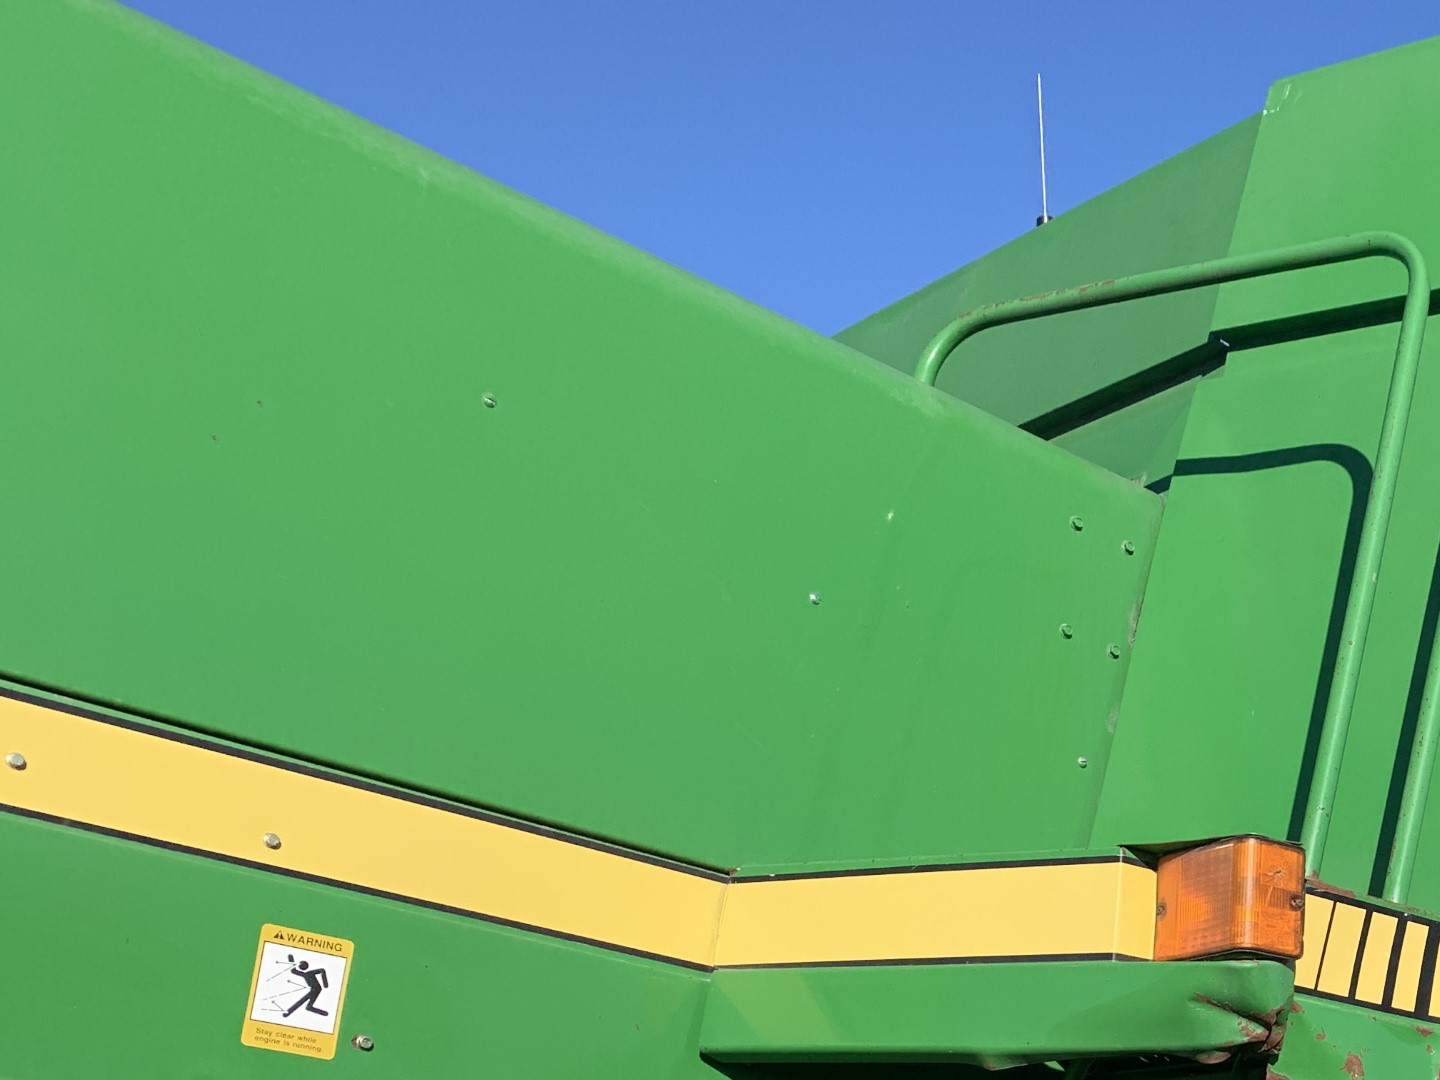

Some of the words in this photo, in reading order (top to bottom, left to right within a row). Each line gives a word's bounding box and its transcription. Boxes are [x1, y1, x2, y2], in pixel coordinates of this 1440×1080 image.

[286, 932, 343, 952] WARNING
[254, 1035, 281, 1044] engine
[283, 1039, 290, 1047] is
[256, 1027, 273, 1037] Stay
[275, 1031, 295, 1040] clear
[297, 1035, 317, 1044] while
